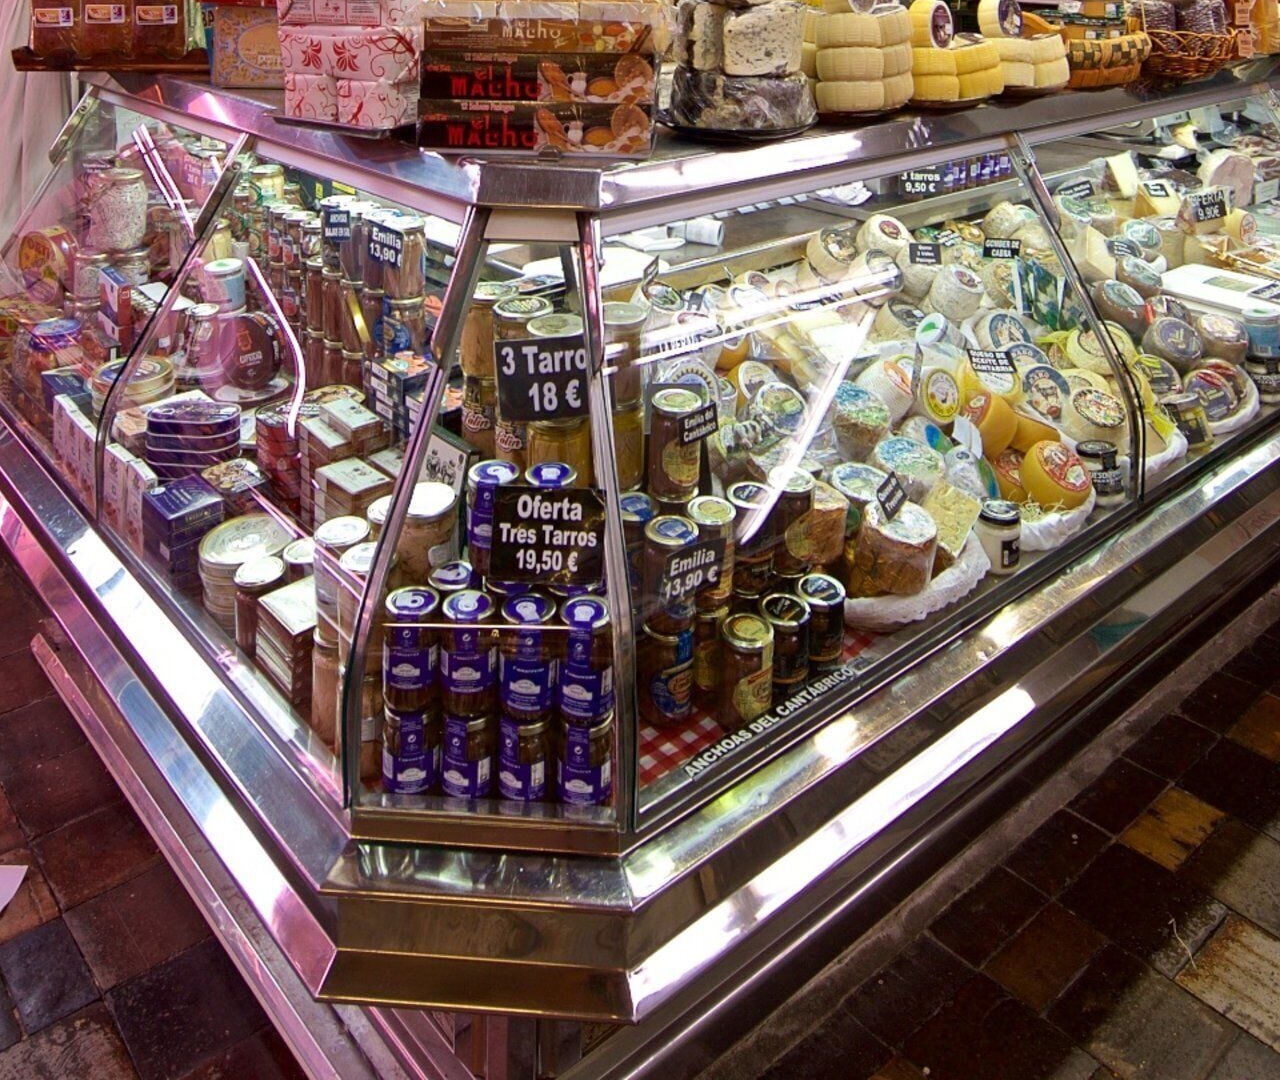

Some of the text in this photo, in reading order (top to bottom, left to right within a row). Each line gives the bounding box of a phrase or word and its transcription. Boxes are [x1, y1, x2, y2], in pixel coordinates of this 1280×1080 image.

[905, 181, 936, 193] 9,50 €
[909, 171, 941, 182] tarros
[372, 227, 401, 250] Emilia
[369, 243, 396, 263] 13,90
[501, 347, 516, 376] 3
[528, 379, 582, 412] 18 €
[684, 414, 704, 428] Emilia
[516, 494, 583, 521] Oferta
[499, 522, 598, 548] Tres Tarros
[515, 549, 579, 574] 19,50 €
[670, 548, 716, 577] Emilia
[664, 566, 718, 599] 13,90 €
[684, 666, 857, 778] ANCHOAS DEL CANTÁBRICO
